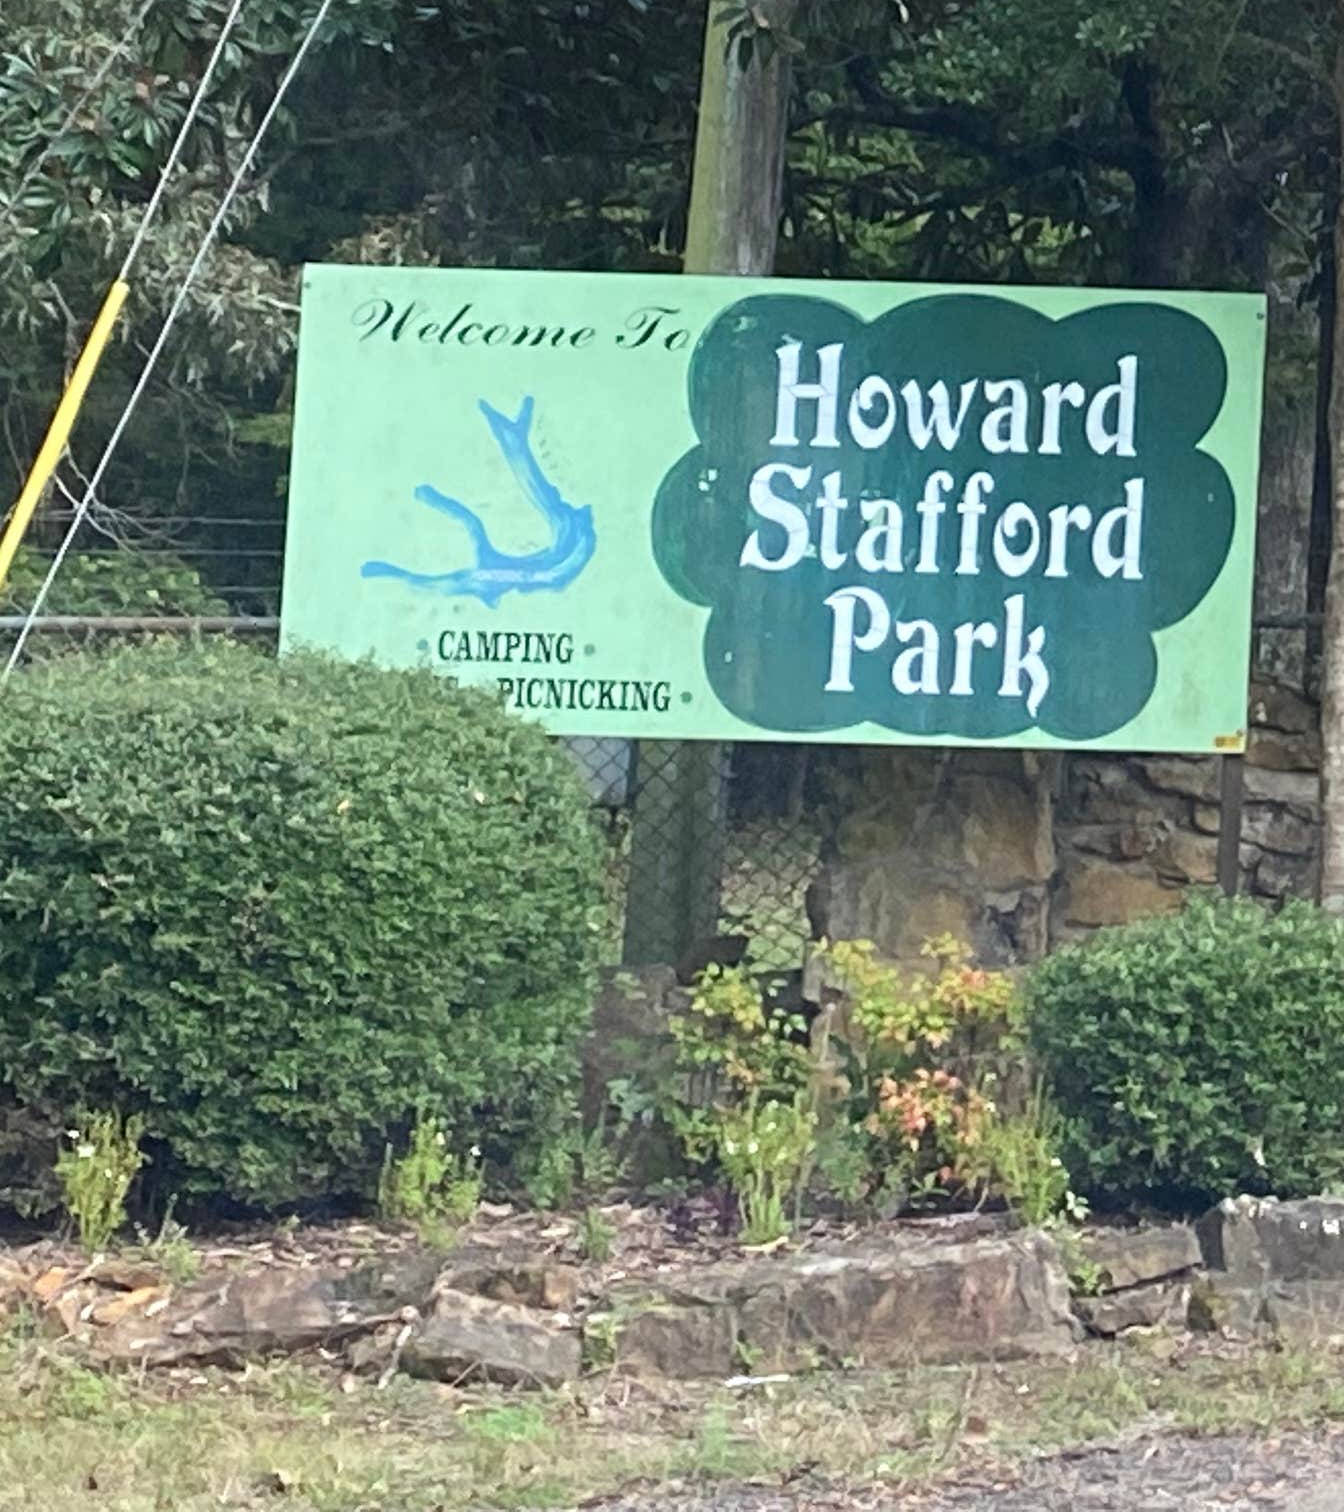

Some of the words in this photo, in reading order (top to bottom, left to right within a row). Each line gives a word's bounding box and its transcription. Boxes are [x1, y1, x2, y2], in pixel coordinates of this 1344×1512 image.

[351, 298, 597, 349] Welcome
[615, 305, 692, 353] To
[769, 342, 1138, 457] Howard
[738, 462, 1145, 580] Stafford
[438, 630, 574, 664] CAMPING
[823, 585, 1050, 718] Park
[496, 677, 672, 713] PICNICKING
